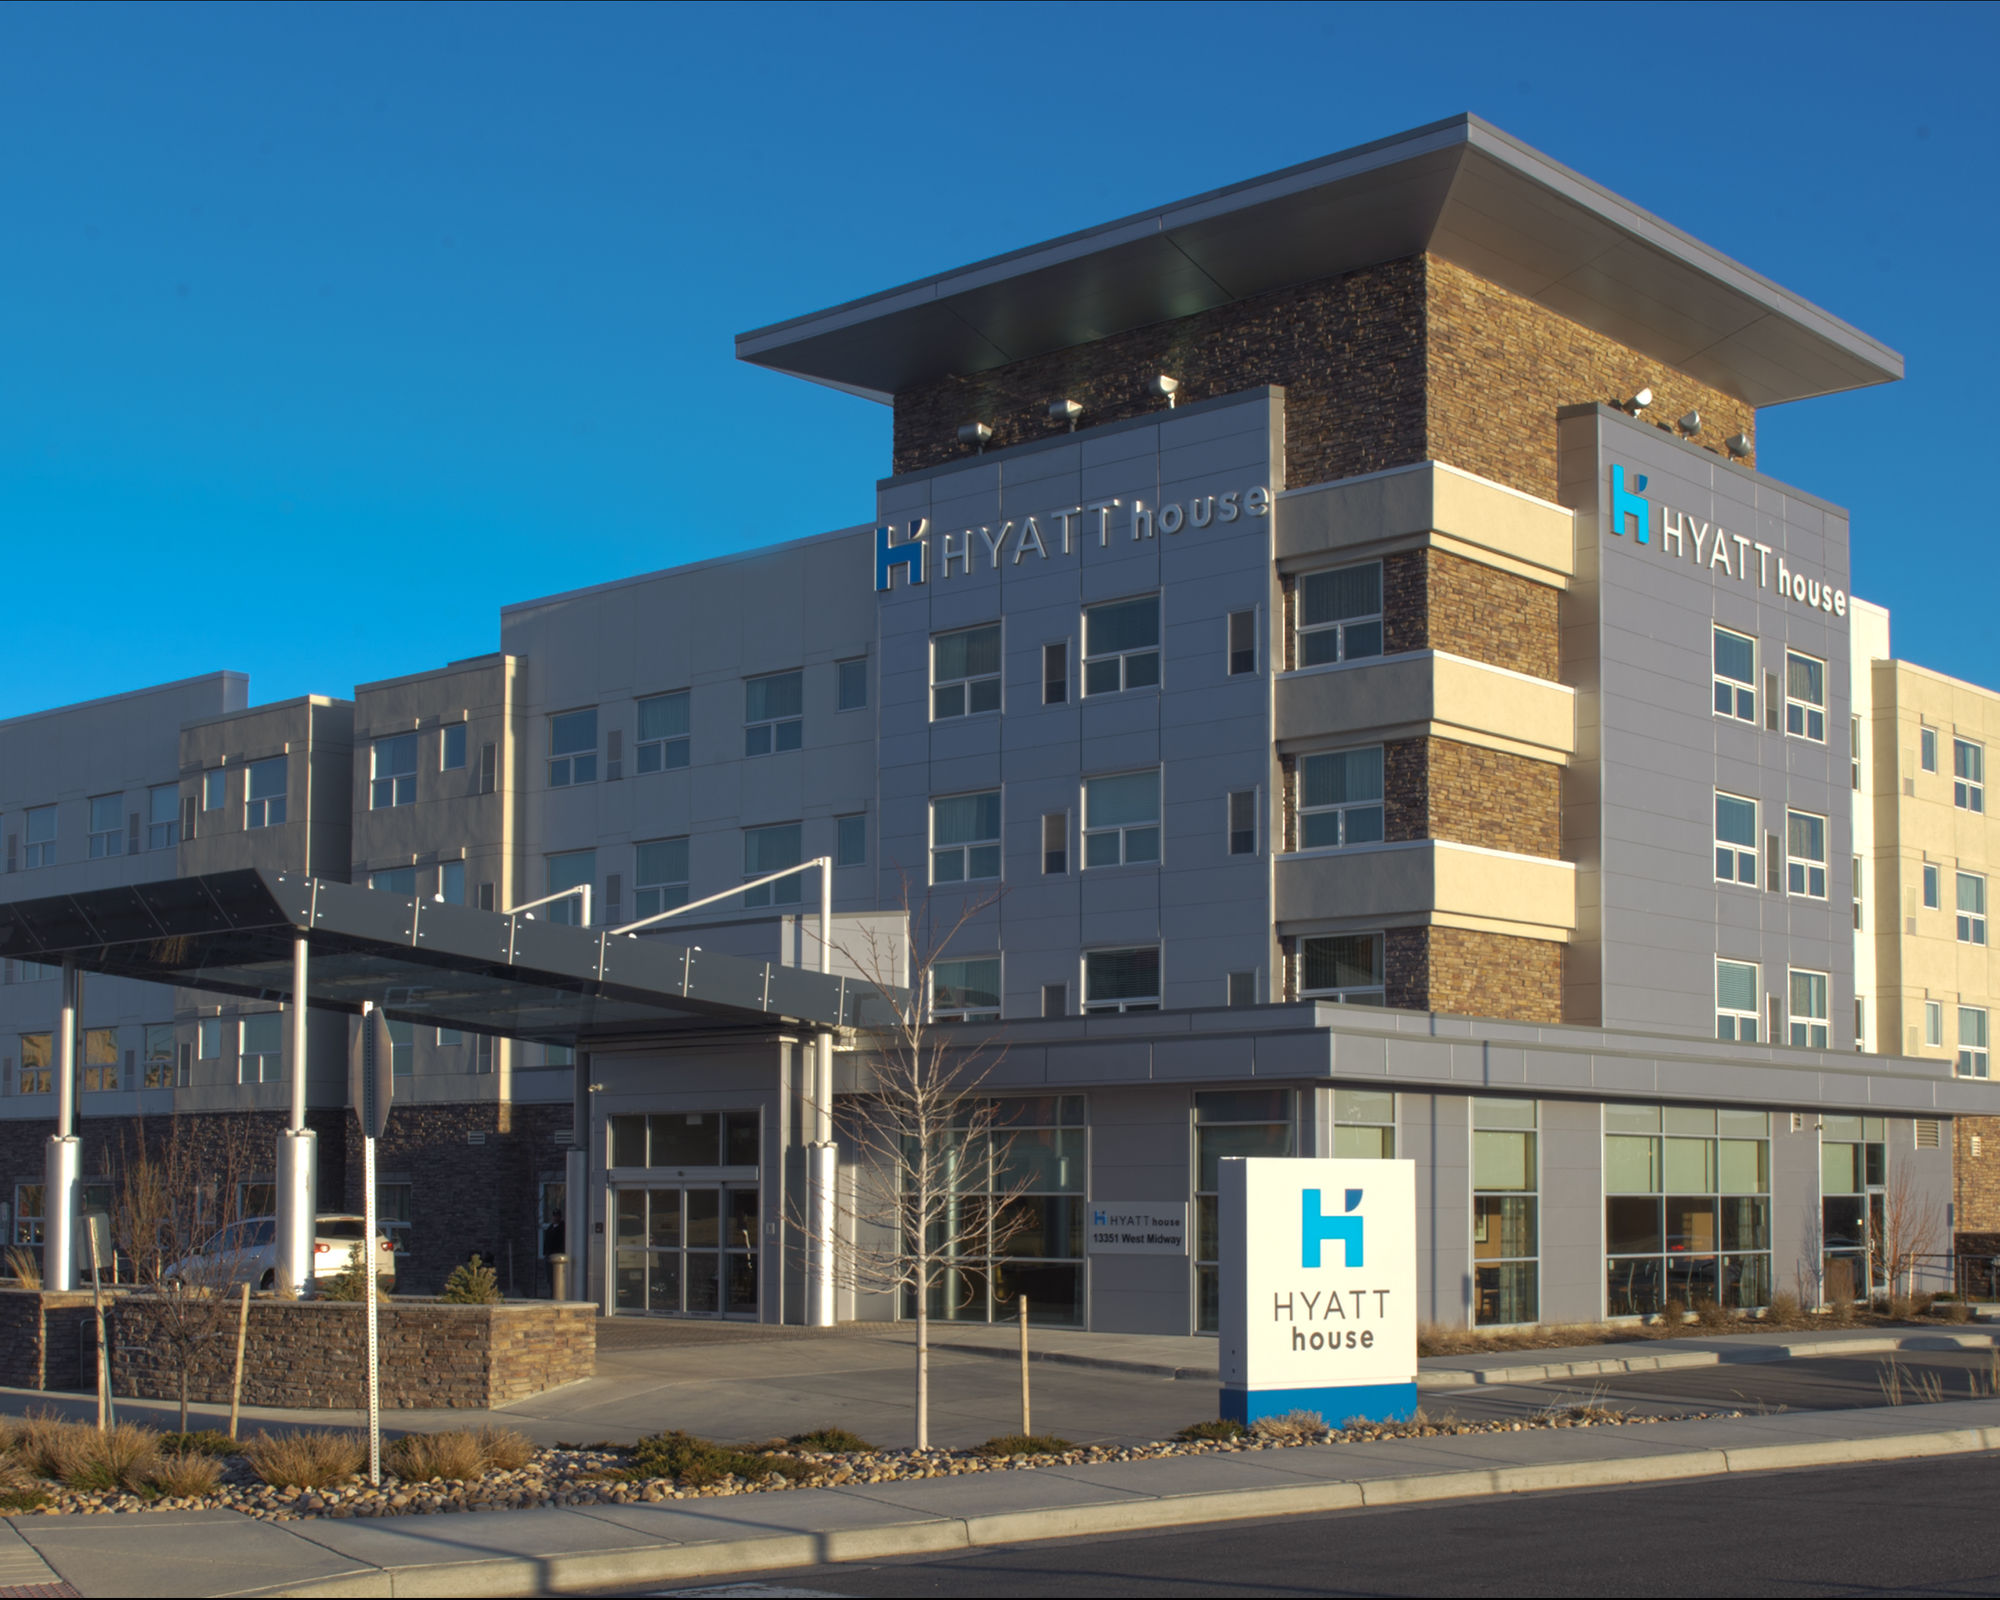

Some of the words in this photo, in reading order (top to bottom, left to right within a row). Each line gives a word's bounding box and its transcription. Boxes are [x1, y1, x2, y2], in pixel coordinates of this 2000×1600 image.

[940, 498, 1121, 578] HYATT
[1130, 486, 1269, 541] house
[1661, 506, 1771, 588] HYATT
[1776, 557, 1847, 616] house
[1110, 1215, 1149, 1226] HYATT
[1152, 1218, 1180, 1226] house
[1094, 1233, 1118, 1243] 13351
[1121, 1234, 1144, 1243] West
[1147, 1234, 1181, 1246] Midway
[1274, 1289, 1390, 1321] HYATT
[1292, 1326, 1374, 1351] house
